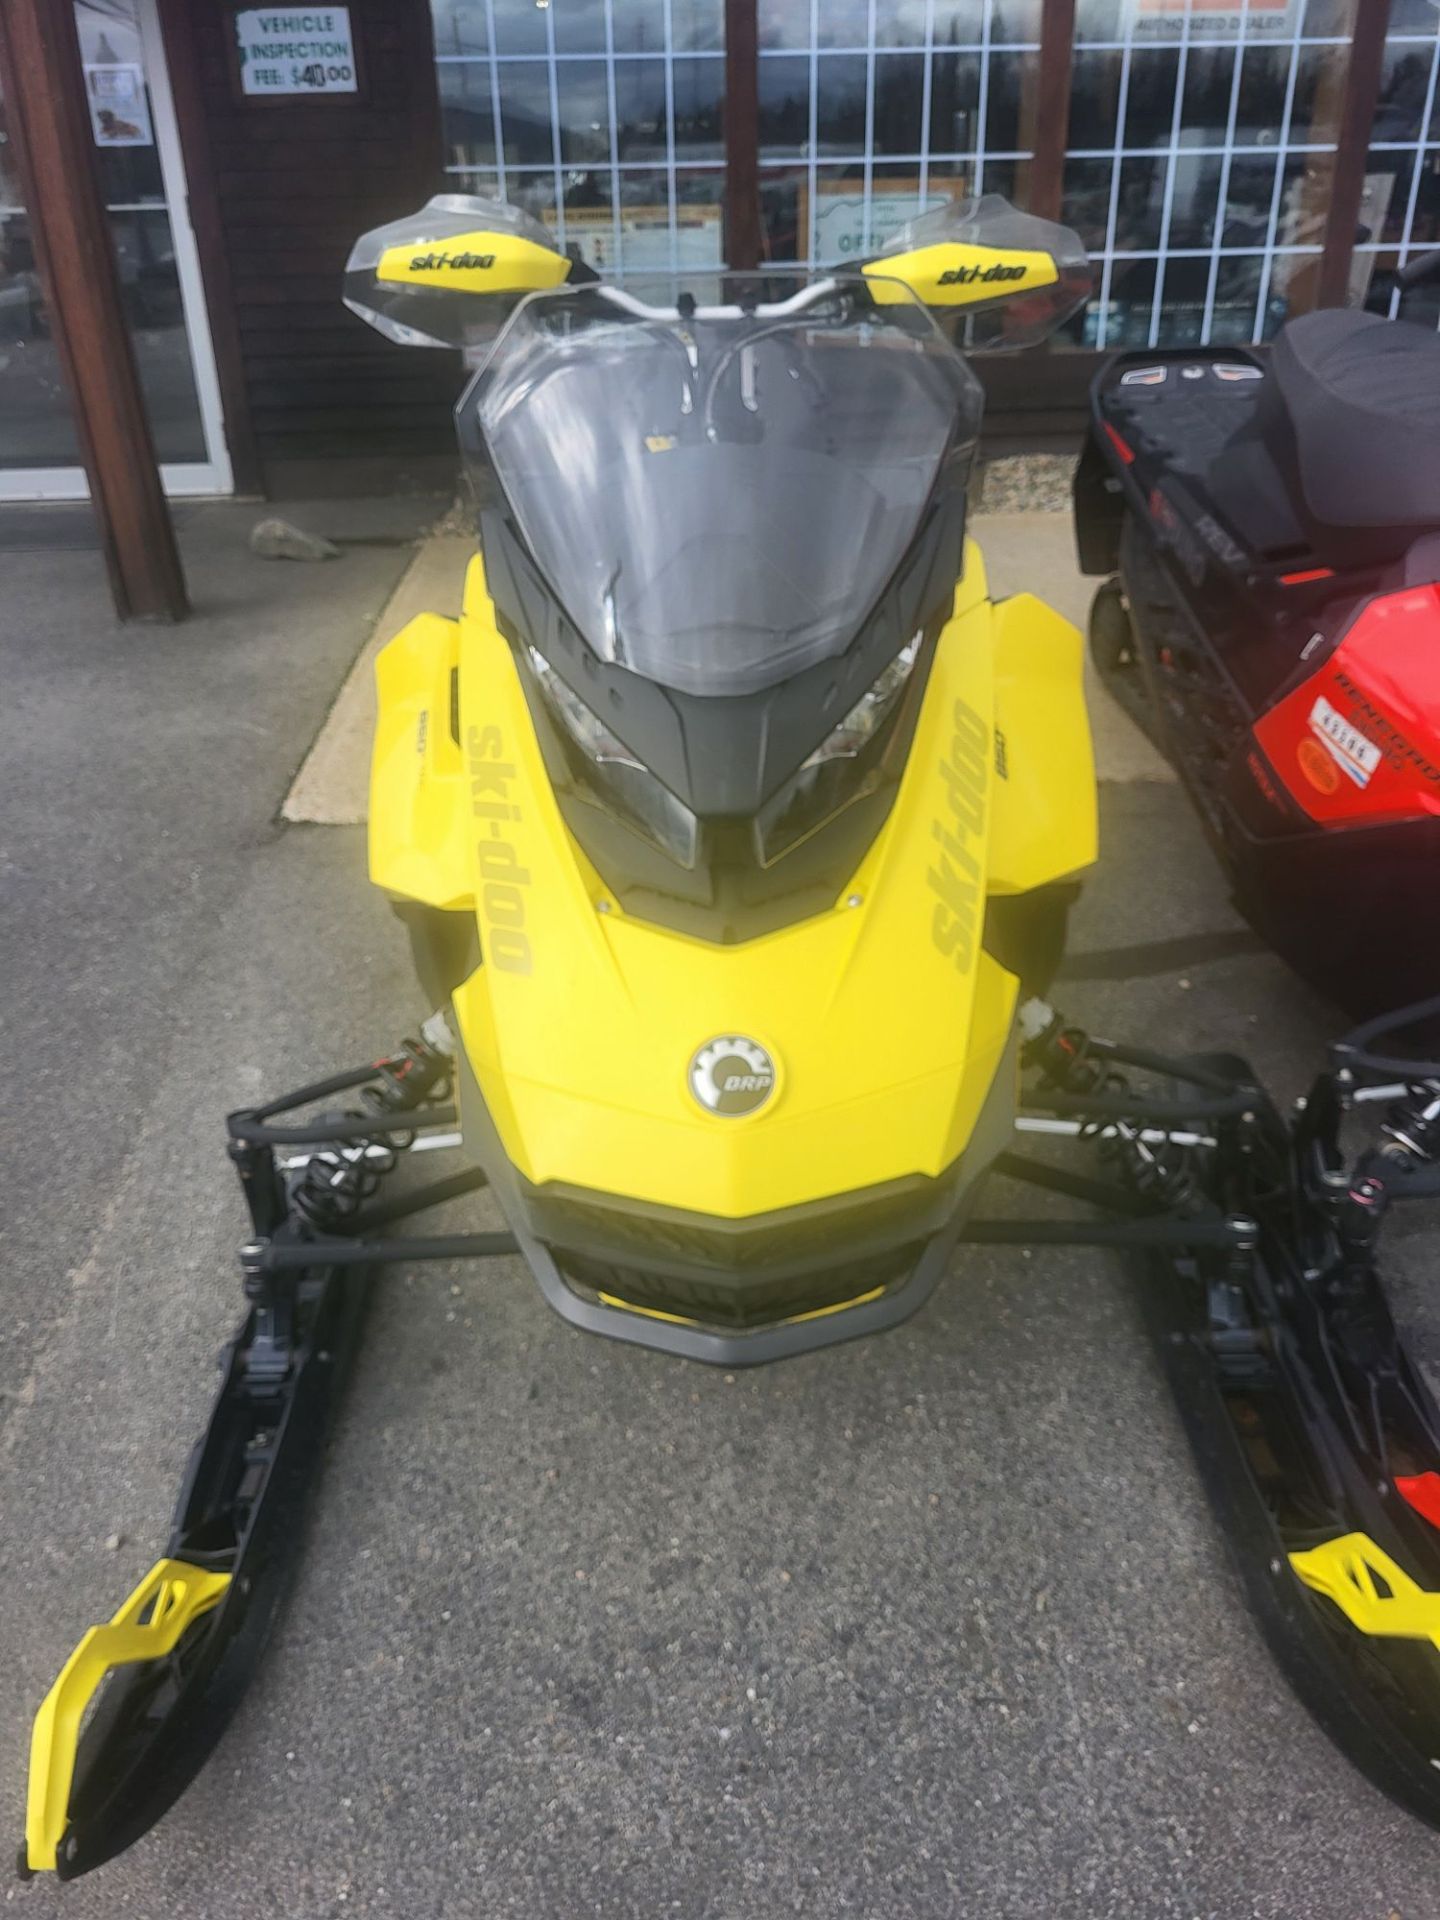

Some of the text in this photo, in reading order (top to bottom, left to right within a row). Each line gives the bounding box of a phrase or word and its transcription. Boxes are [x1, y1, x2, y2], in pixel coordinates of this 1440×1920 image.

[258, 15, 334, 33] VEHICLE
[251, 42, 347, 59] INSPECTION
[253, 69, 284, 85] FEE:
[408, 251, 496, 271] ski-doo
[936, 263, 1027, 285] ski-doo
[926, 697, 989, 976] ski-doo
[466, 724, 534, 977] ski-doo
